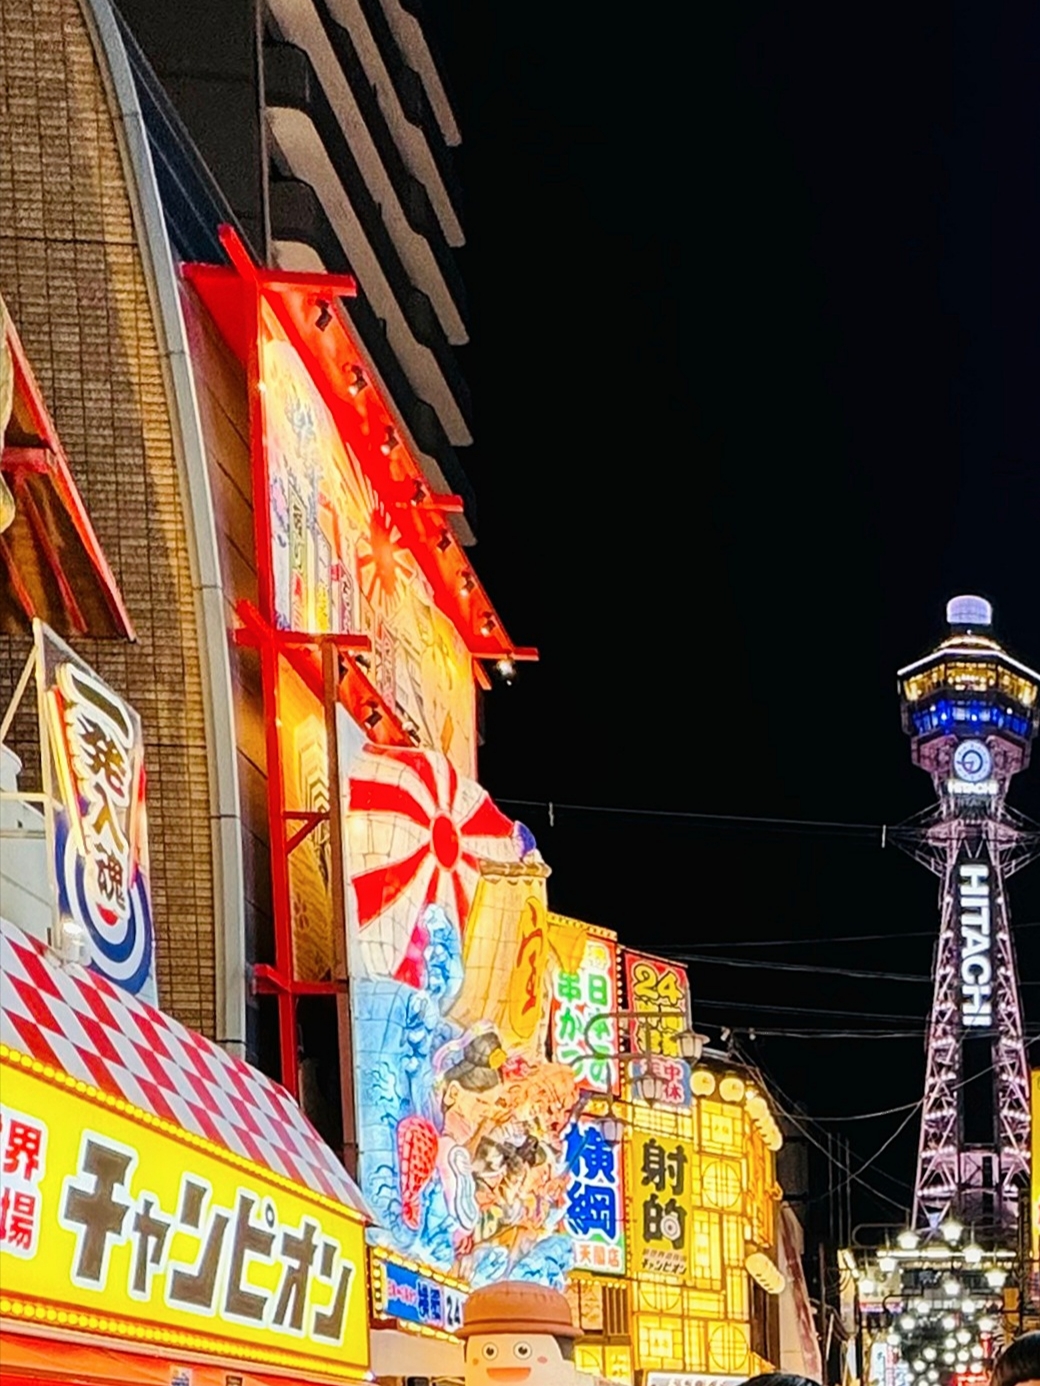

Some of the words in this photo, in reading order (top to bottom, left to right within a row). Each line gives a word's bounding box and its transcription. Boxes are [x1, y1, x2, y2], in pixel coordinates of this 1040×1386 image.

[632, 962, 685, 1007] 24
[959, 863, 993, 1027] HITACHI
[0, 1114, 43, 1182] 界
[565, 1122, 616, 1240] 横綱
[641, 1138, 688, 1250] 射的
[63, 1137, 353, 1342] チャンピオン
